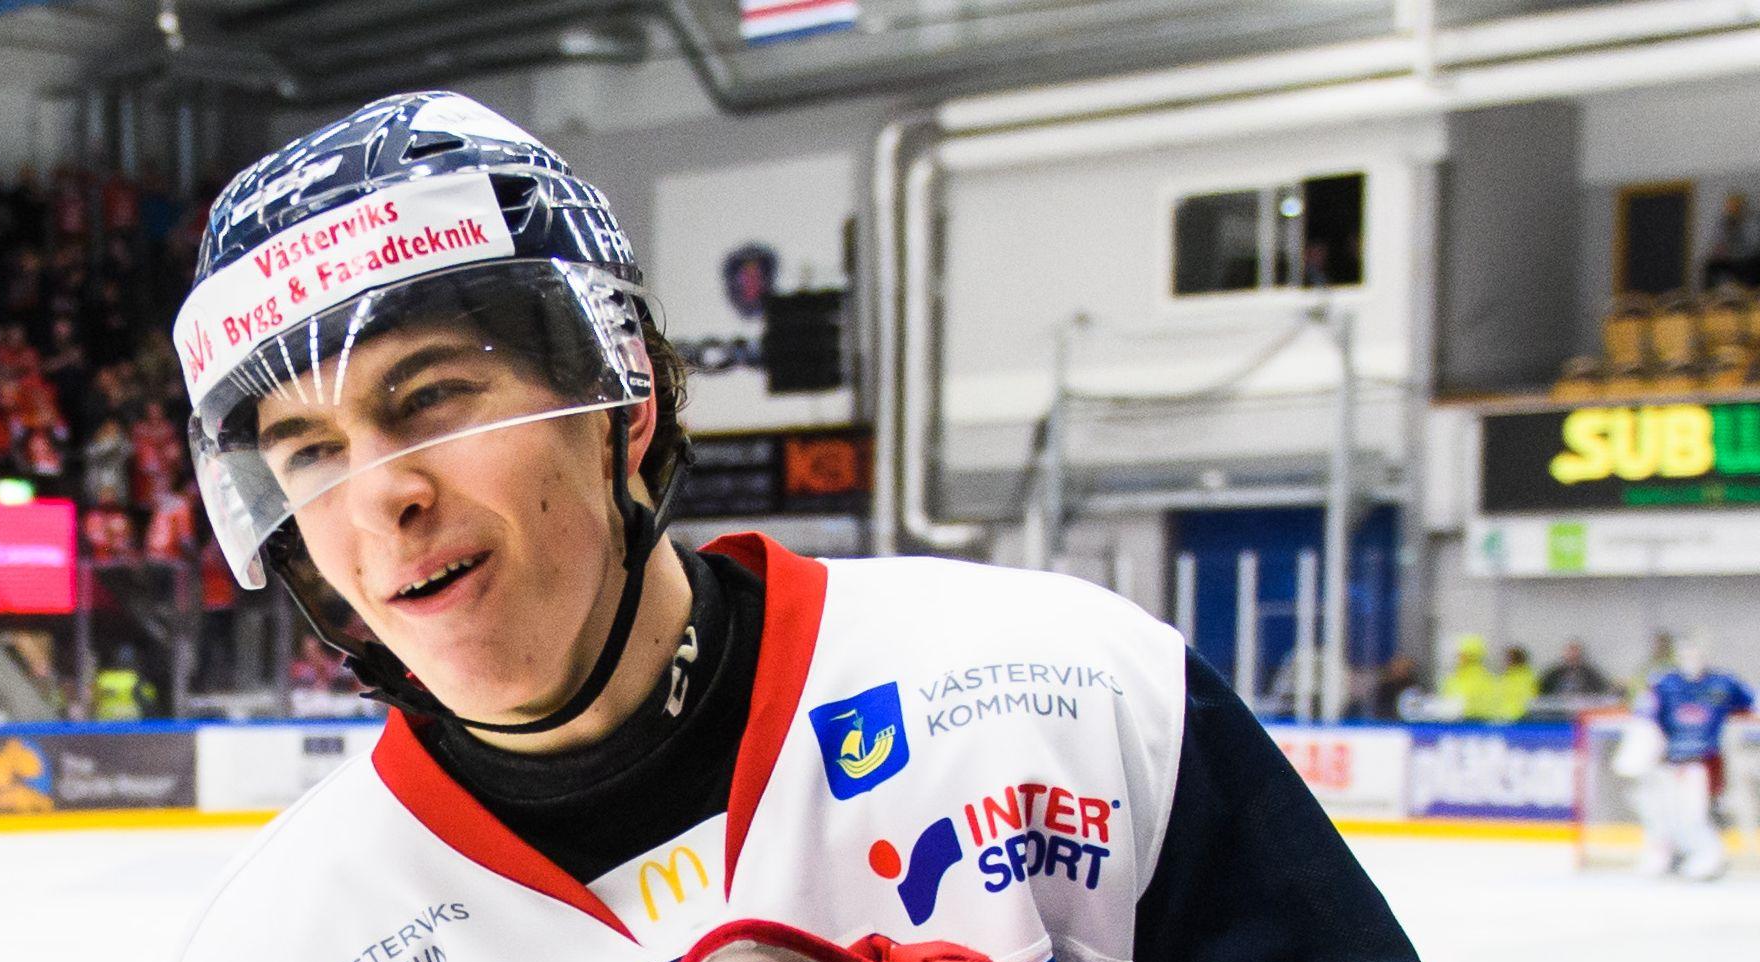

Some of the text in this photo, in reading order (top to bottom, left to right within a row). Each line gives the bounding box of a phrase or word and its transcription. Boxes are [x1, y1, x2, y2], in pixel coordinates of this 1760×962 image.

[255, 200, 399, 279] Västerviks
[223, 218, 490, 346] Bygg & Fasadteknik
[918, 662, 1125, 703] VÄSTERVIKS
[926, 693, 1079, 738] KOMMUN
[964, 783, 1113, 848] INTER
[978, 830, 1111, 894] SPORT
